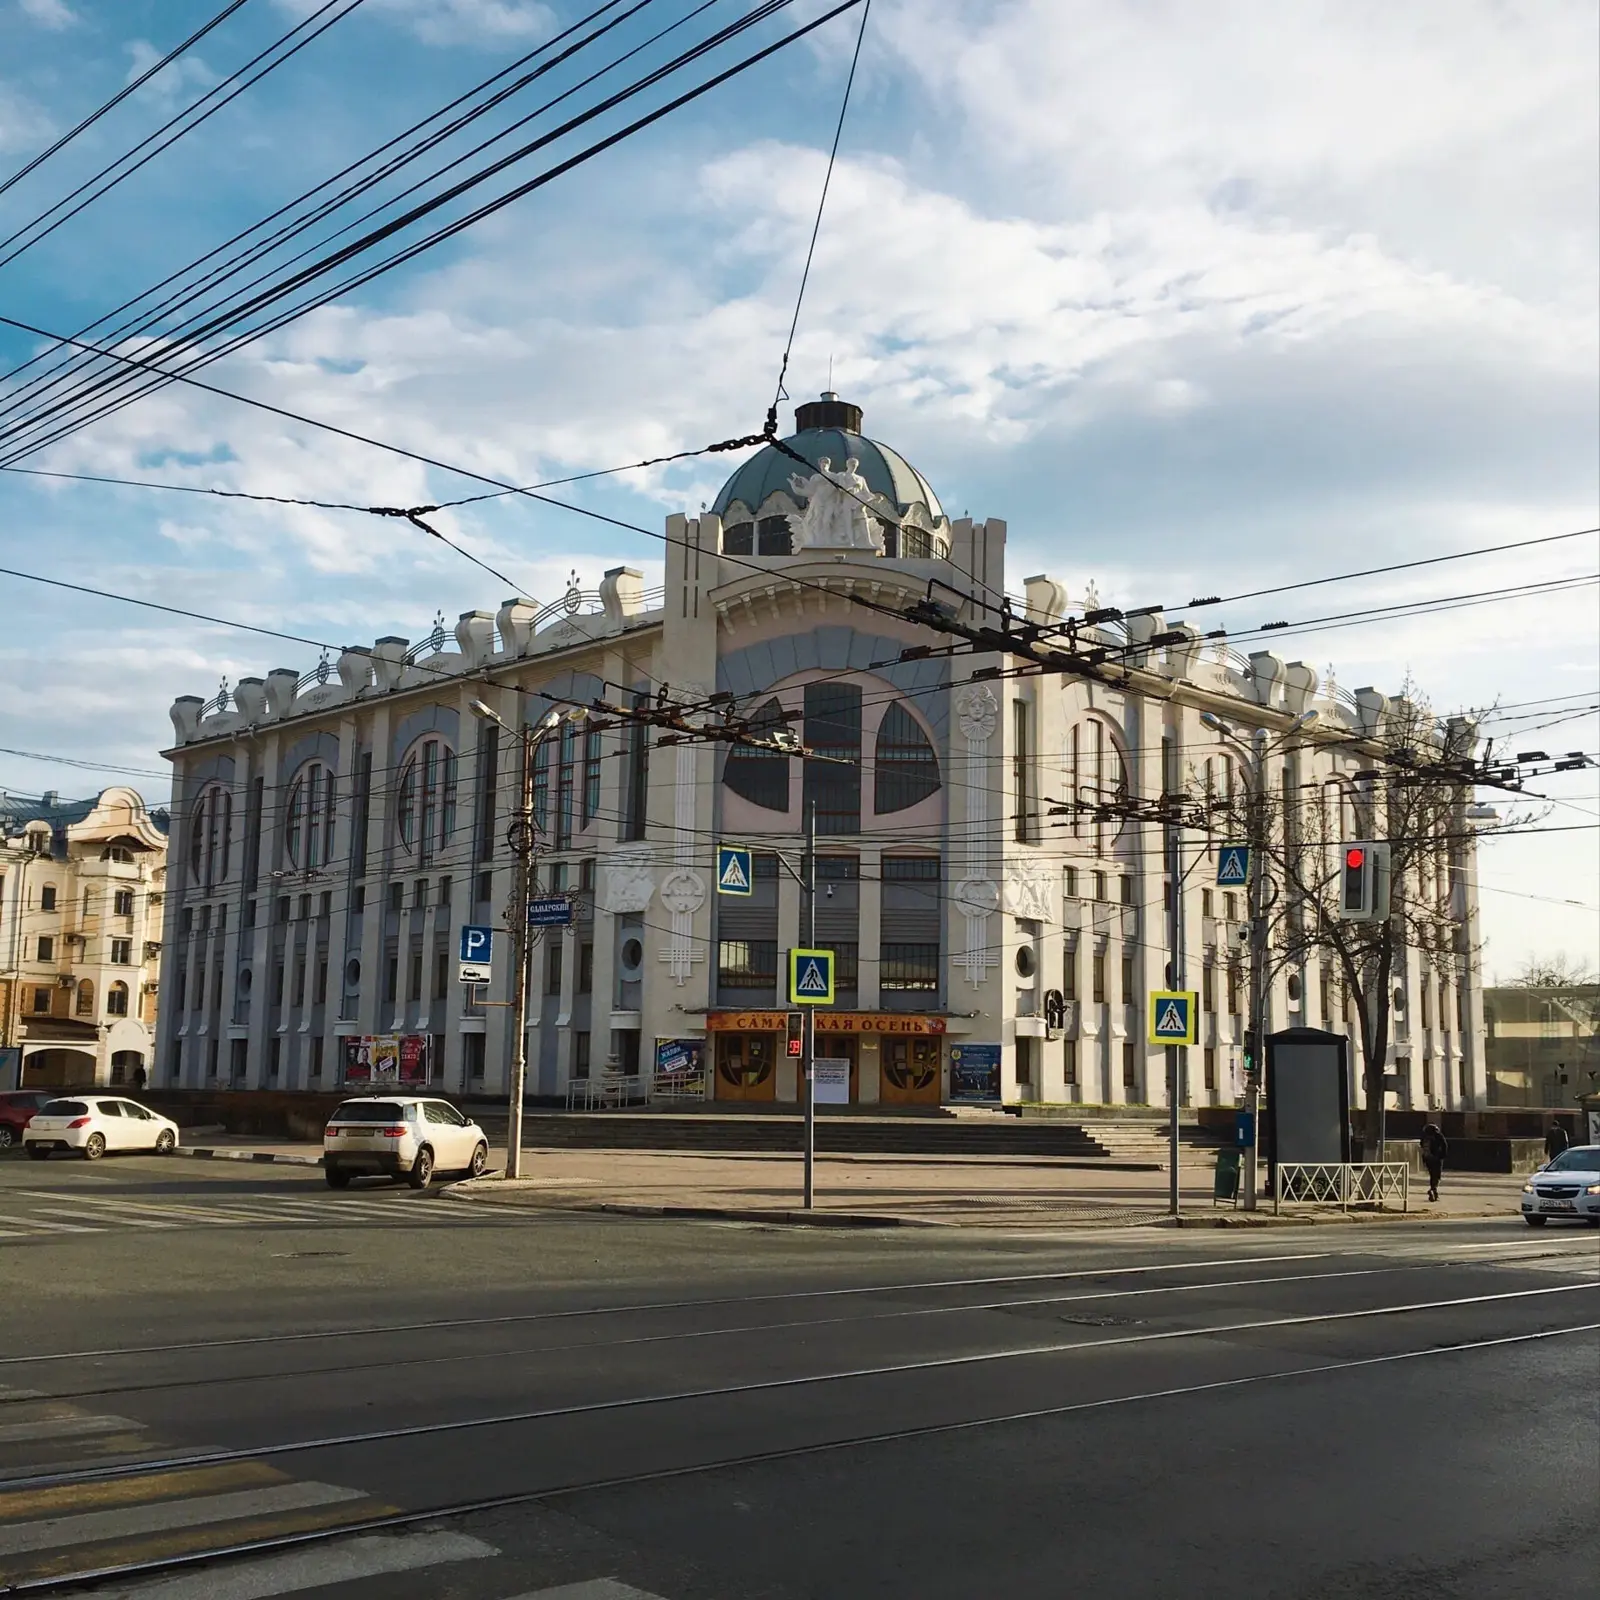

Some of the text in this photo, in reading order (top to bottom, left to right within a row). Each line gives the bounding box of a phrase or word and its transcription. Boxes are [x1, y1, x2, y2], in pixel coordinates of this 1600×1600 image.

[467, 930, 485, 958] P
[737, 1018, 923, 1032] САМАКАЯ ОСЕНЬ
